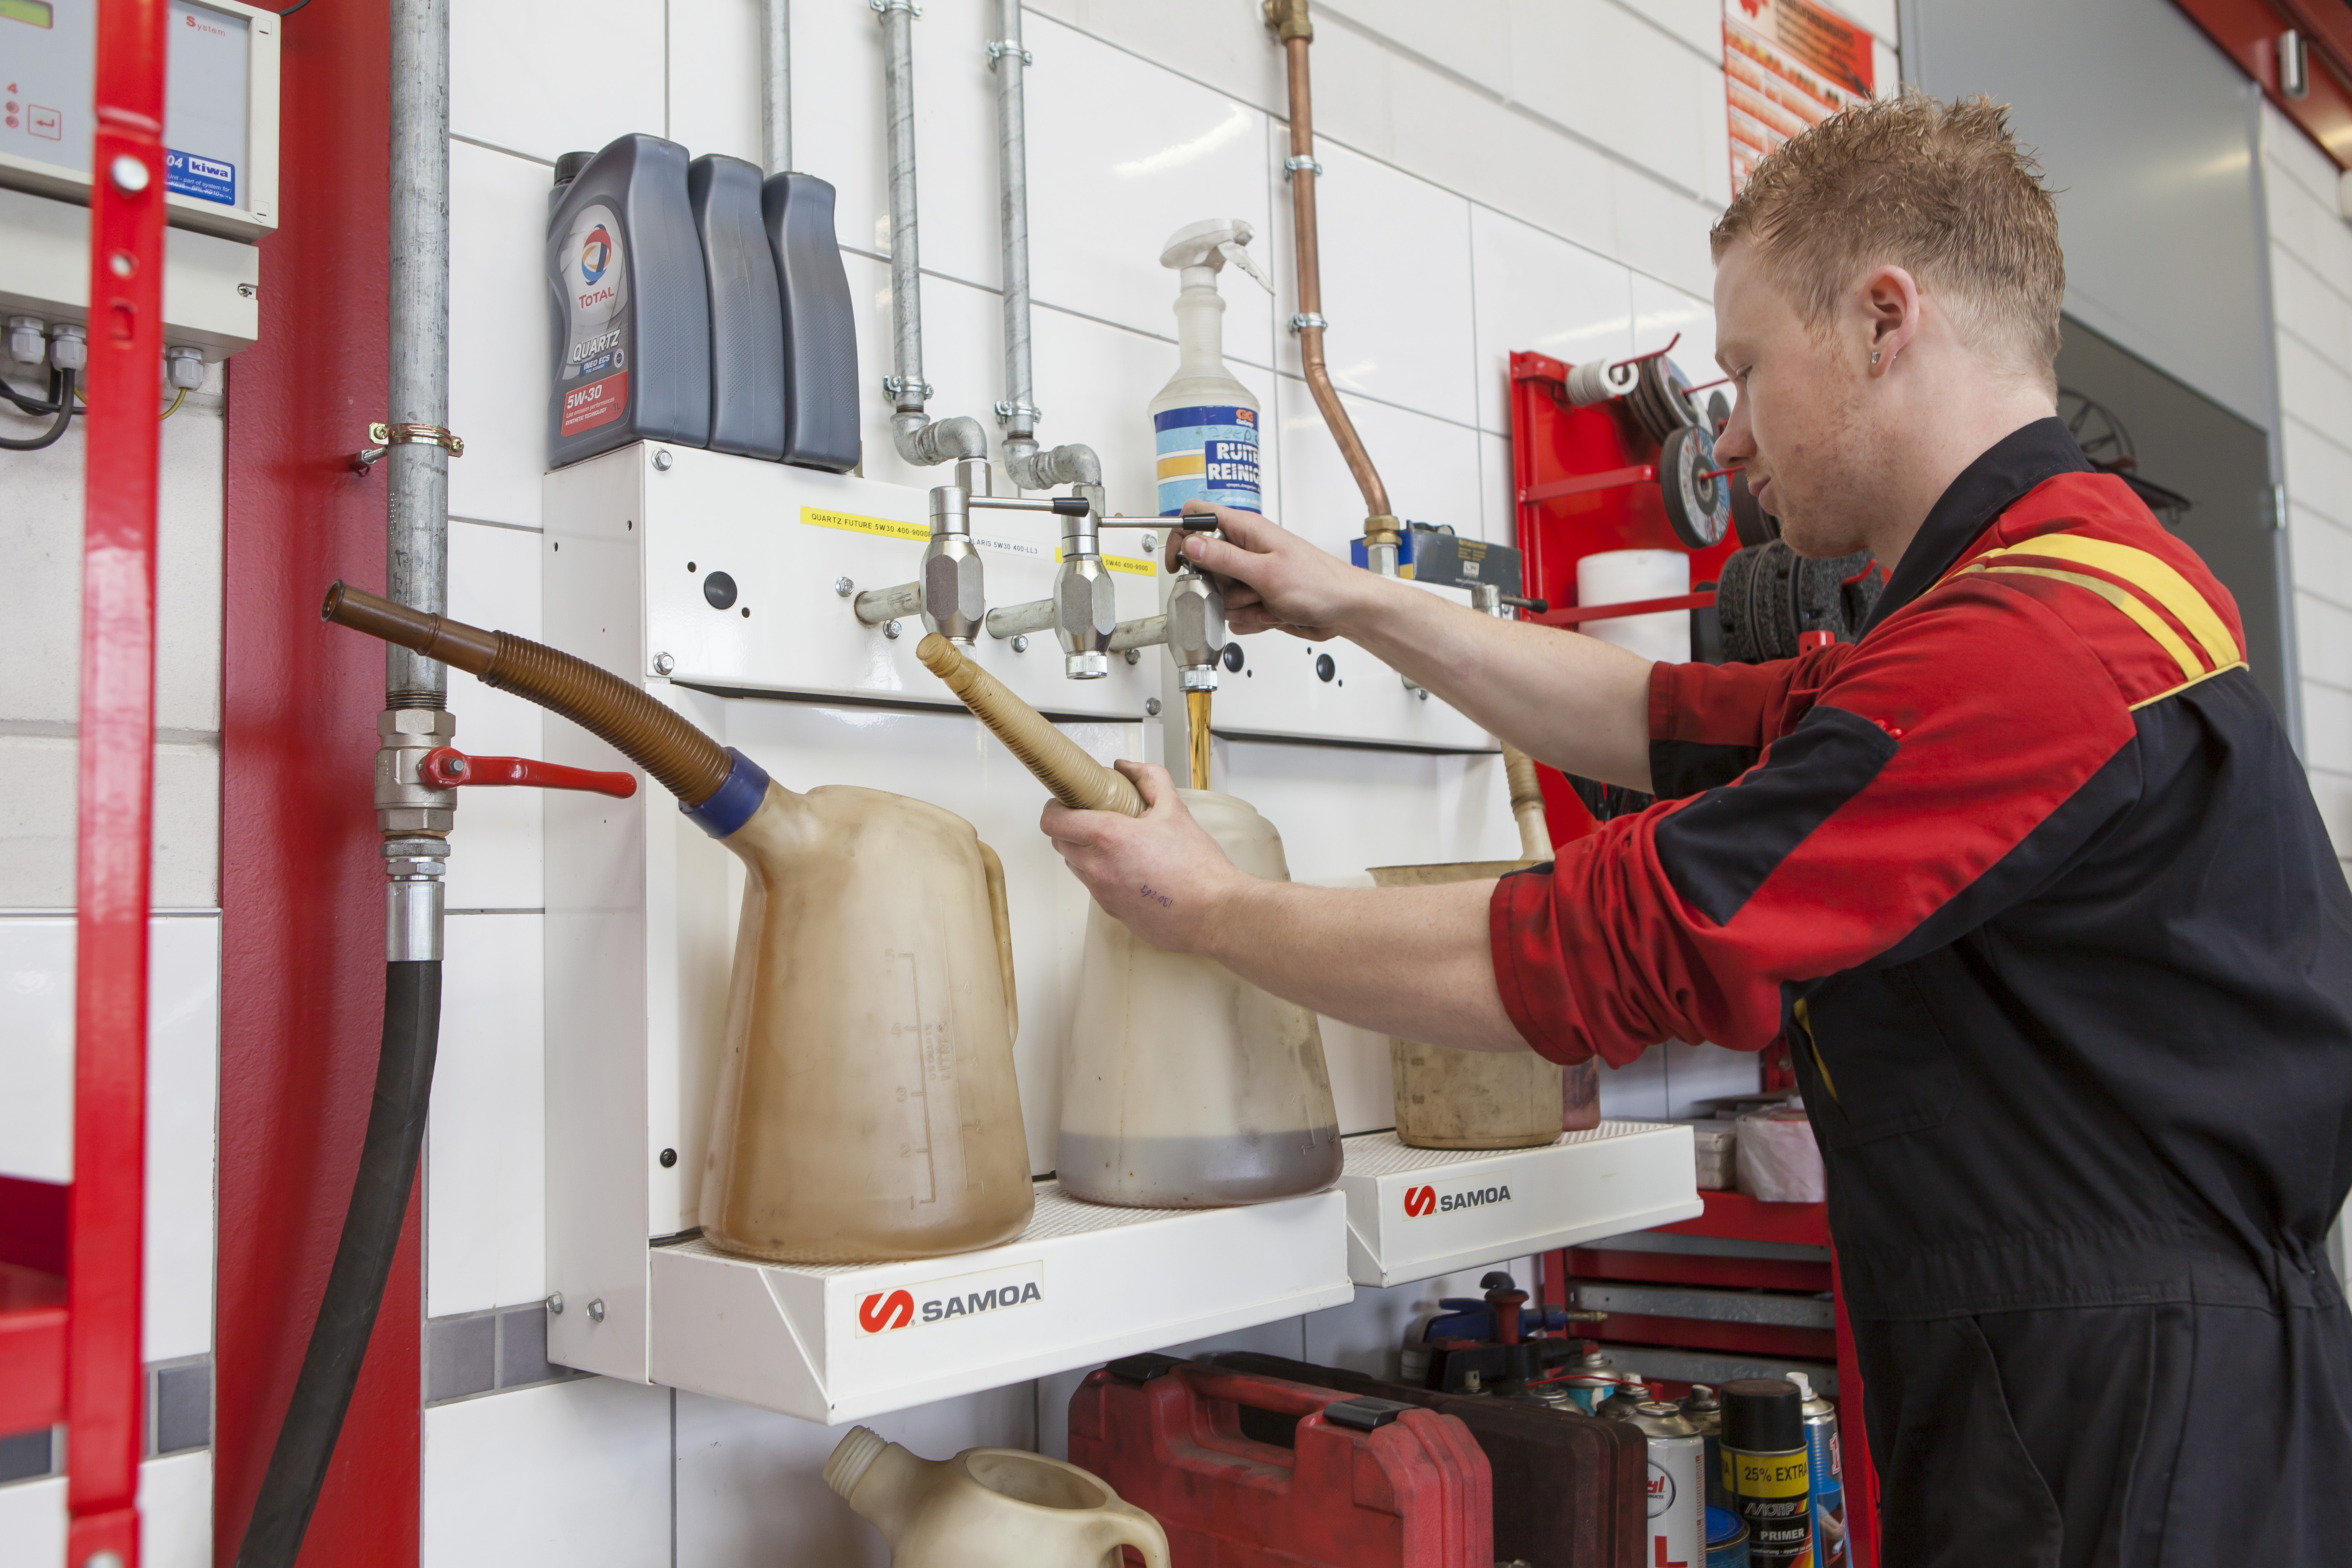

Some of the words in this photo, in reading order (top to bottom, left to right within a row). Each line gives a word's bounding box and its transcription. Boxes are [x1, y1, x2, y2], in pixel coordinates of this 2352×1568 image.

[186, 15, 225, 36] System
[191, 160, 229, 178] kiwa
[579, 287, 615, 309] TOTAL
[573, 329, 621, 363] QUARTZ
[583, 359, 598, 371] INEO
[598, 354, 610, 365] ECS
[567, 384, 603, 409] 5W-30
[574, 406, 590, 415] emission
[589, 397, 615, 411] performances
[565, 415, 584, 426] SYNTHETIC
[584, 406, 607, 420] TECHNOLOGY
[812, 513, 842, 525] QUARTZ
[844, 519, 872, 529] FUTURE
[875, 524, 895, 532] 5W30
[993, 542, 1011, 550] 5W30
[1013, 545, 1038, 554] 400-LL3
[1123, 562, 1148, 571] 400-9000
[1440, 1185, 1511, 1212] SAMOA
[922, 1282, 1042, 1323] SAMOA
[1744, 1466, 1772, 1482] 25%
[1776, 1461, 1808, 1482] EXTRA
[1760, 1528, 1805, 1541] PRIMER
